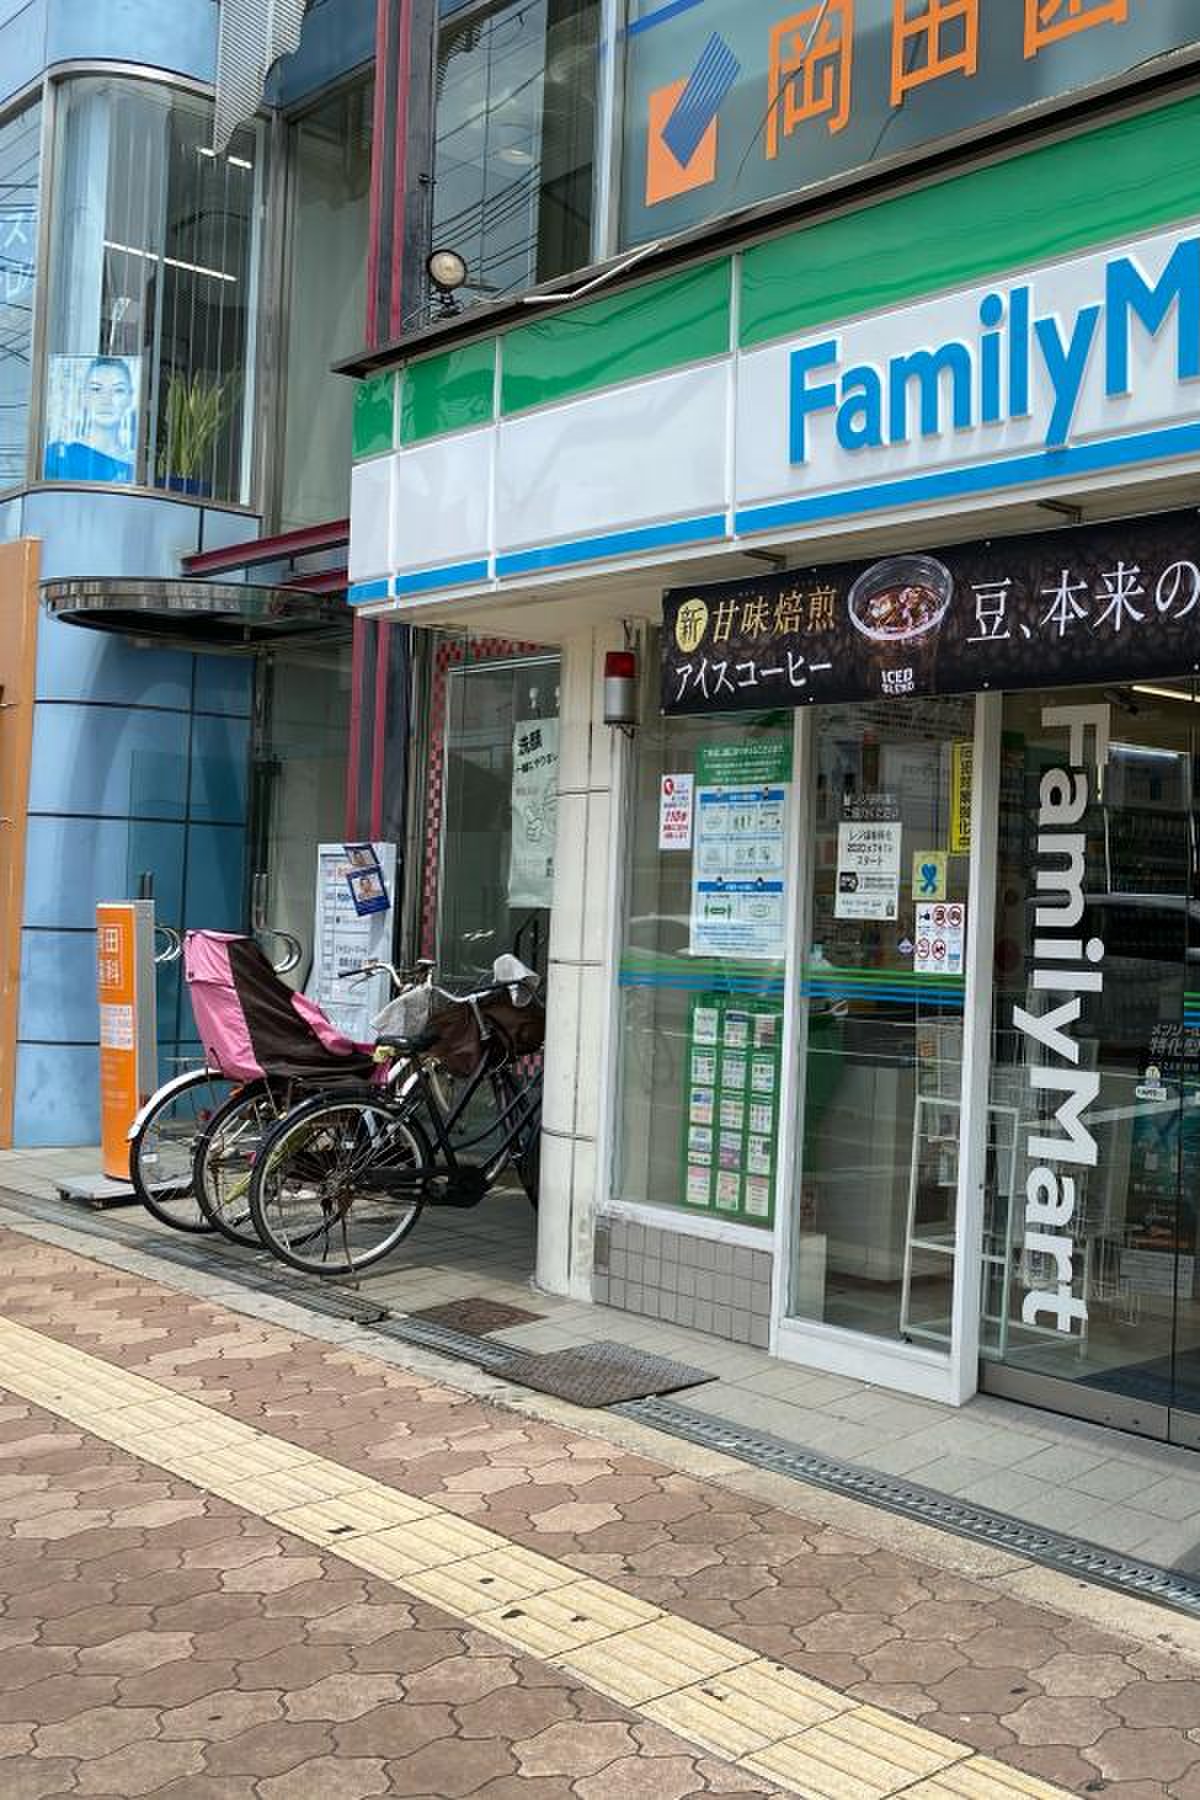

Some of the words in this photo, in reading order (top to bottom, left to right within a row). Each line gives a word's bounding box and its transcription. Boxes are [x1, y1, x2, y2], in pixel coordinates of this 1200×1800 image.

[676, 652, 833, 702] アイスコーヒー
[881, 667, 913, 684] ICED
[1012, 703, 1111, 1333] FamilyMart
